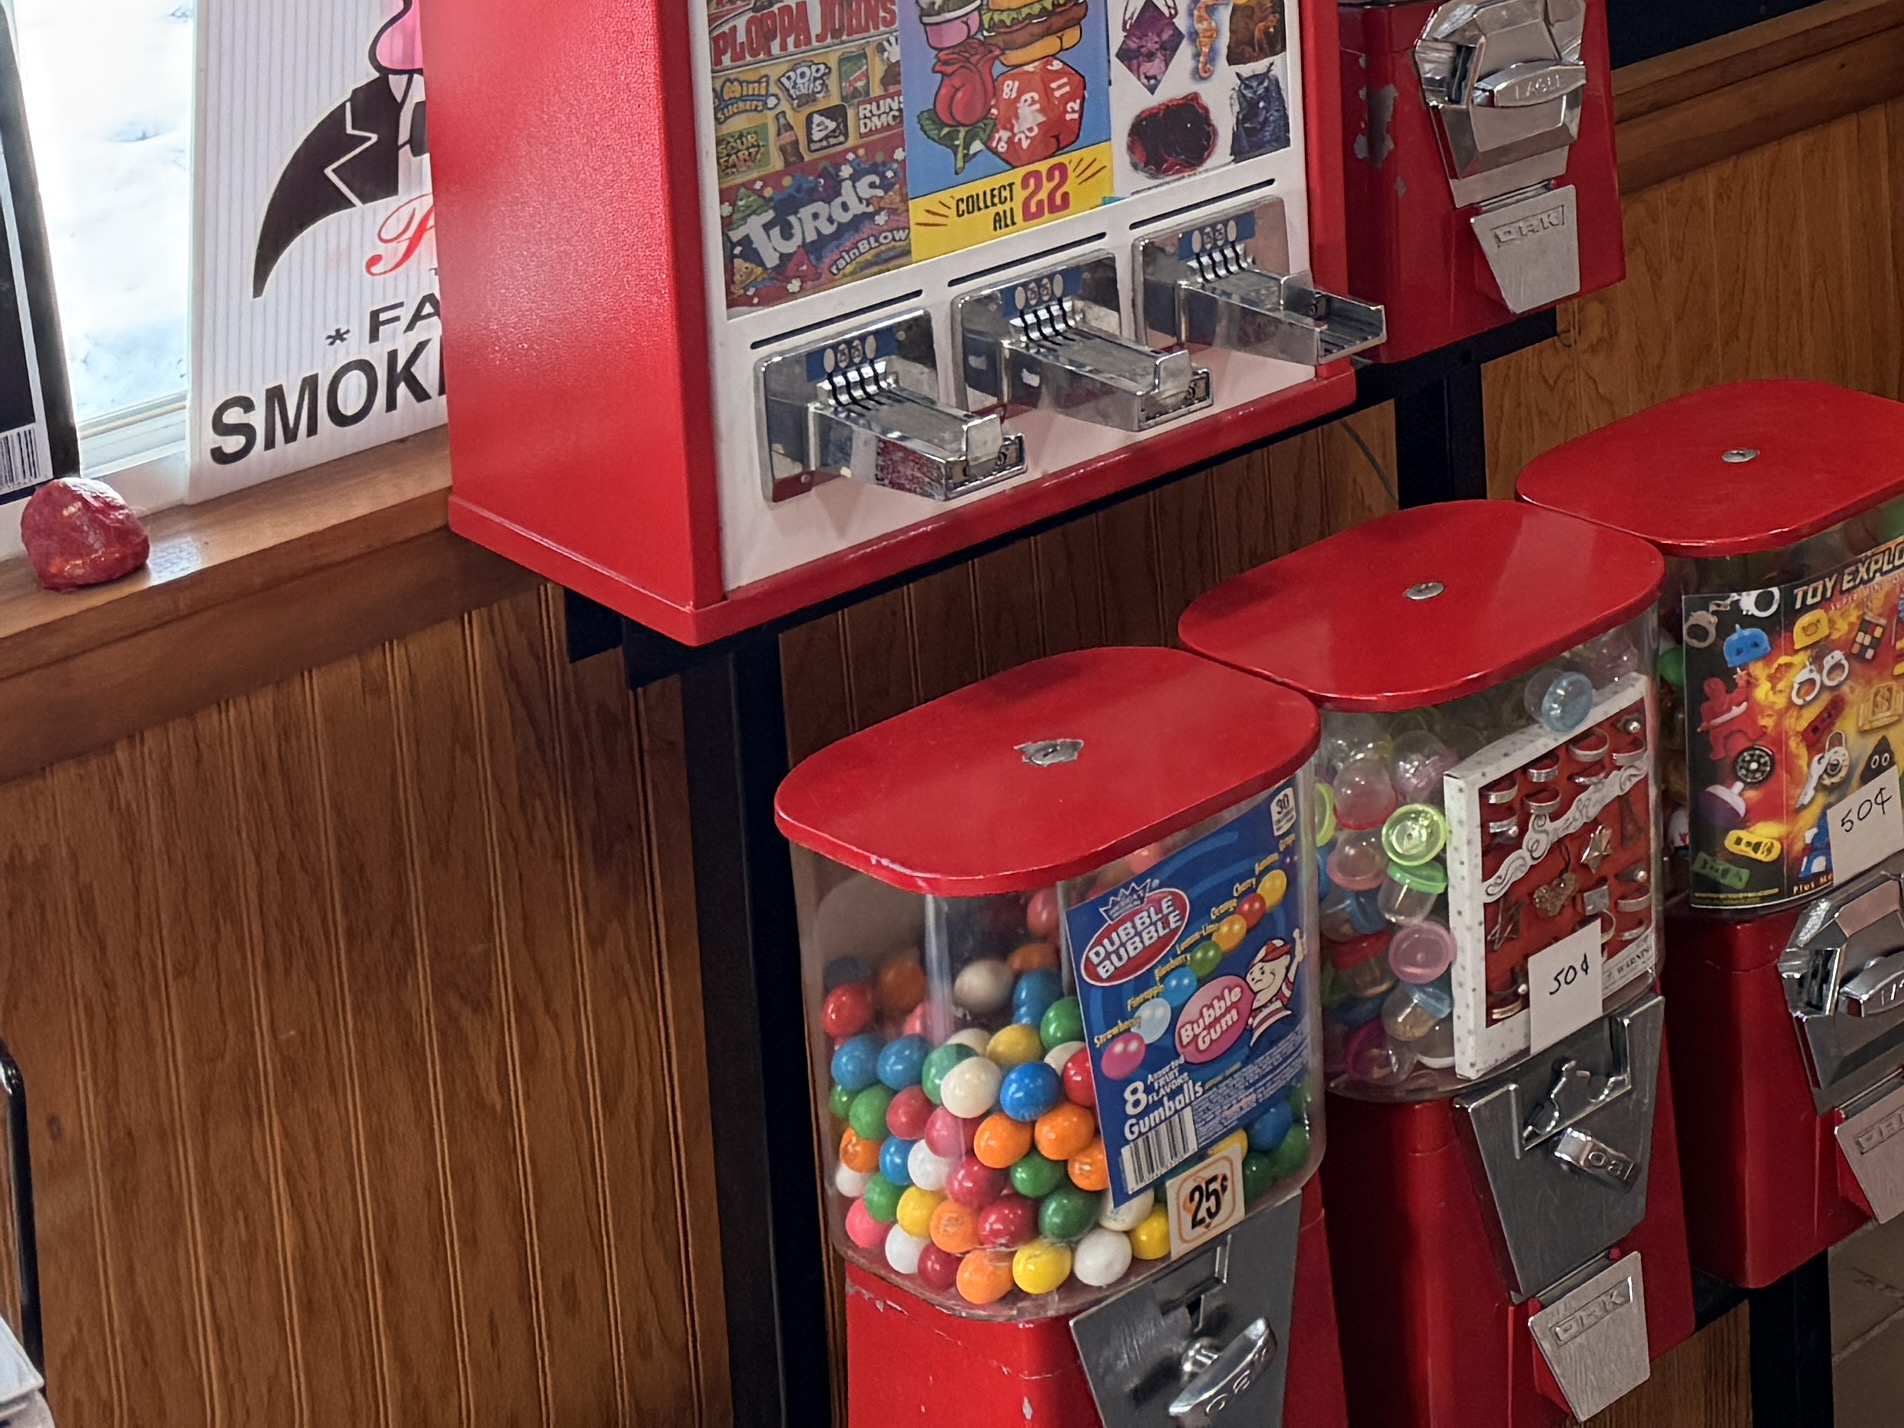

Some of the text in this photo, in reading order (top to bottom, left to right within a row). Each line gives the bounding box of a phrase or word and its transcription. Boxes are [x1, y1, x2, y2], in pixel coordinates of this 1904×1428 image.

[711, 0, 812, 68] PLOPPA
[859, 111, 900, 134] DMC
[955, 181, 1015, 218] COLLECT
[1020, 161, 1071, 223] 22
[992, 207, 1017, 232] ALL
[1793, 582, 1838, 610] TOY
[1276, 792, 1290, 815] 30
[1841, 787, 1893, 832] 50¢
[1088, 897, 1175, 964] DUBBLE
[1096, 911, 1183, 980] BUBBLE
[1179, 985, 1243, 1042] Bubble
[1197, 1008, 1239, 1051] Gum
[1148, 1072, 1190, 1105] FLAVORS
[1153, 1064, 1180, 1090] FRUIT
[1123, 1080, 1148, 1116] 8
[1124, 1081, 1204, 1141] Gumballs
